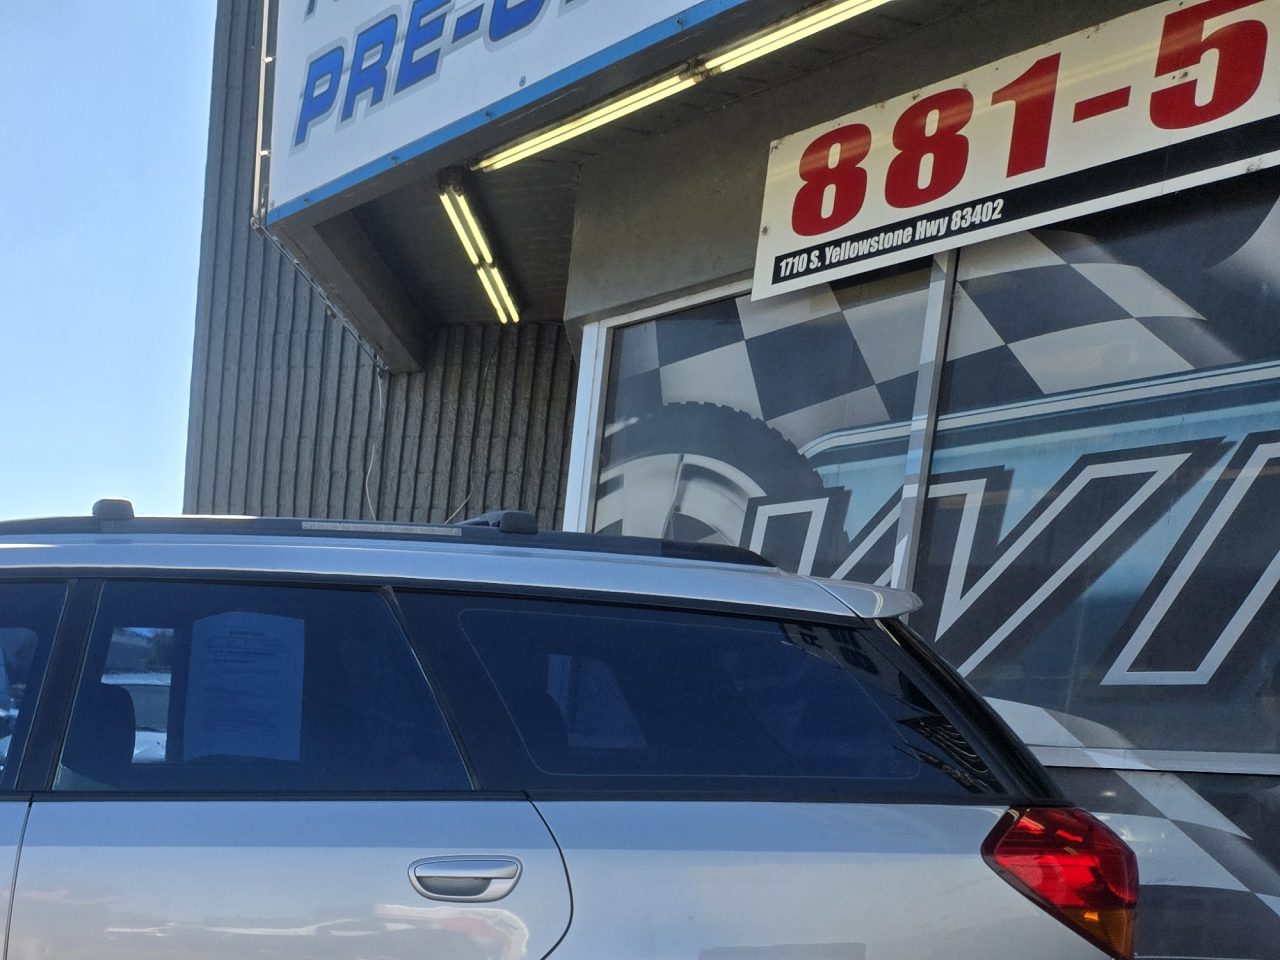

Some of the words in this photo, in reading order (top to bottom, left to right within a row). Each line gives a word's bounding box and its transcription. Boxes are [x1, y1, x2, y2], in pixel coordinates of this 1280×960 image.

[791, 0, 1269, 237] 881-5
[779, 252, 808, 278] 1710
[809, 251, 822, 271] S.
[824, 226, 913, 266] Yellowstone
[914, 215, 949, 241] Hwy
[950, 198, 1005, 231] 83402
